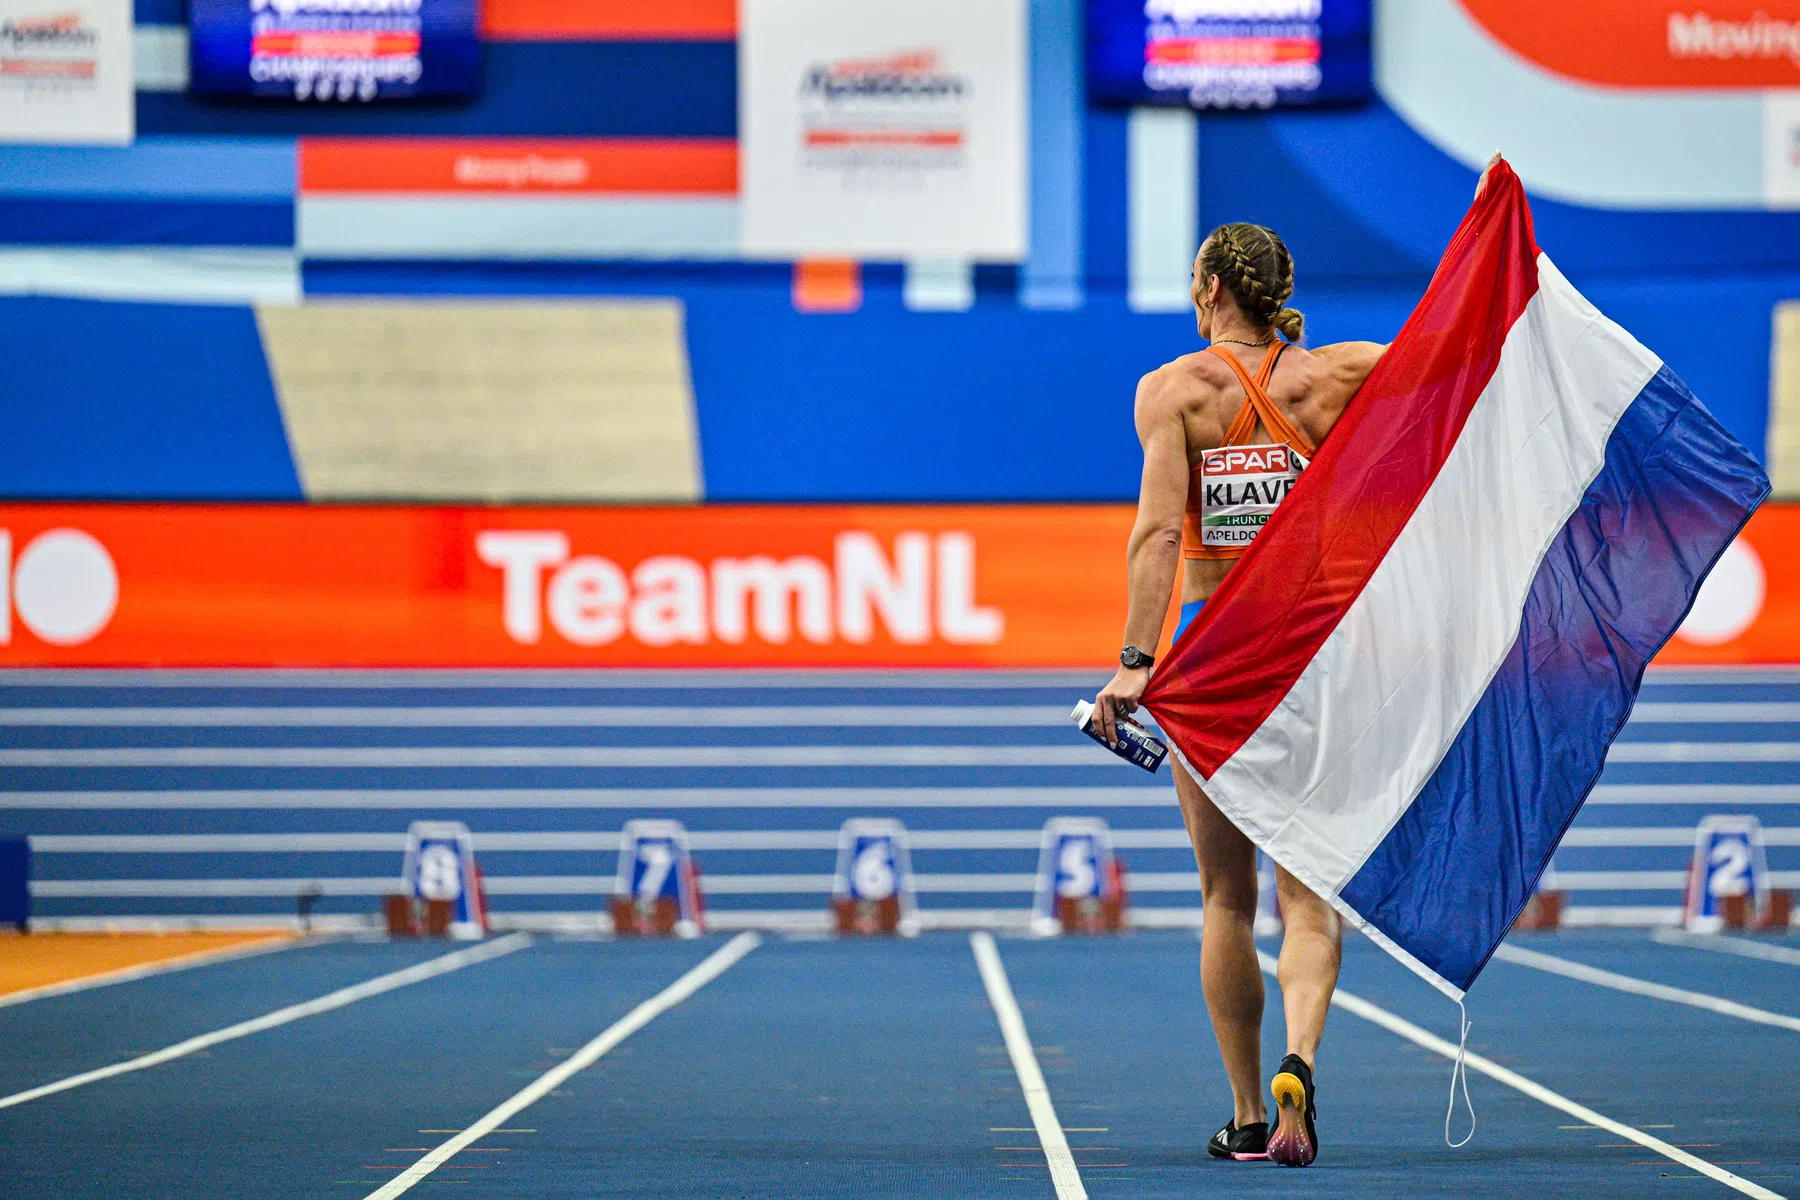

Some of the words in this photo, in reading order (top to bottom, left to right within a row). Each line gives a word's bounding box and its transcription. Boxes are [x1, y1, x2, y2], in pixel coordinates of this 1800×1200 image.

[1205, 450, 1286, 472] SPAR
[1232, 515, 1257, 525] RUN
[476, 530, 1004, 645] TeamNL
[420, 846, 461, 901] 8
[638, 843, 675, 903] 7
[853, 841, 895, 900] 6
[1057, 840, 1097, 898] 5
[1708, 839, 1749, 897] 2
